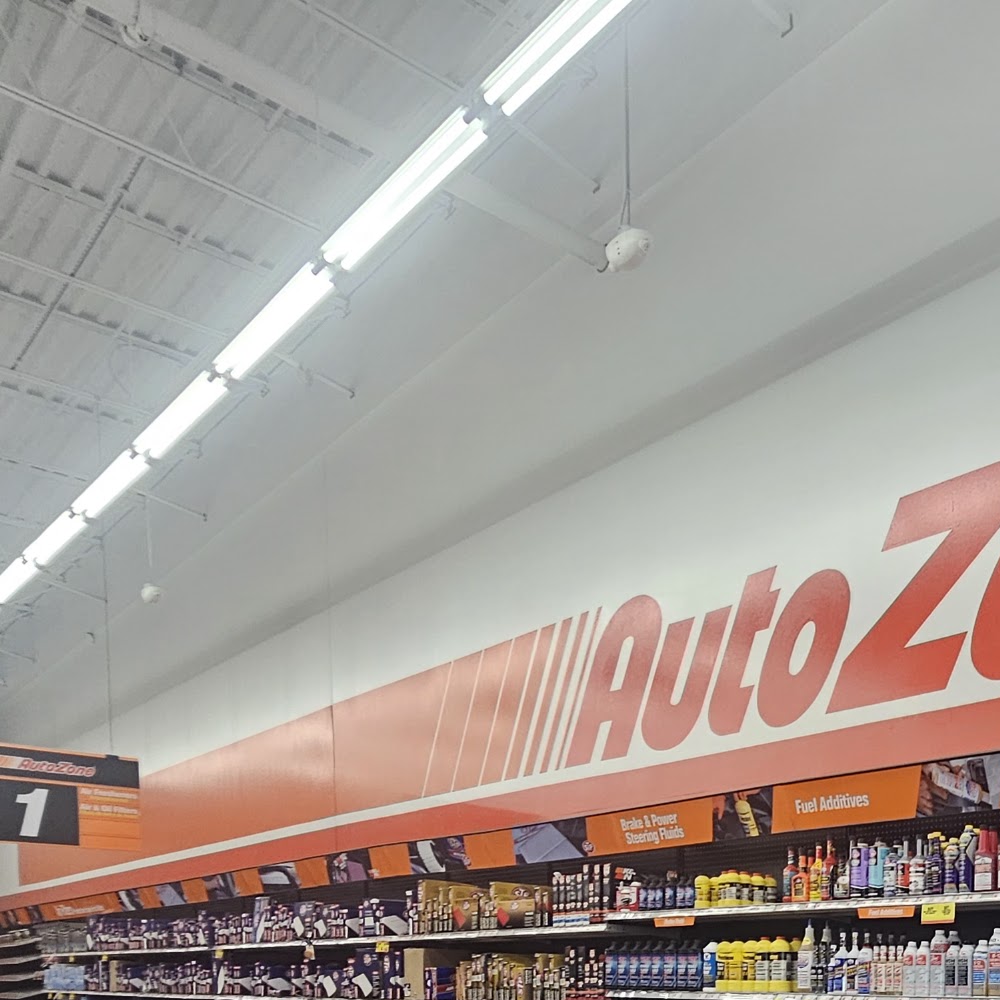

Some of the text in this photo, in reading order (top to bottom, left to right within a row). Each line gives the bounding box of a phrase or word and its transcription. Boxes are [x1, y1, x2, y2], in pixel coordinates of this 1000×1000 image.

[18, 758, 96, 777] AutoZone
[15, 788, 49, 837] 1
[795, 793, 870, 814] Fuel Additives
[620, 813, 678, 831] Brake & Power
[625, 825, 684, 845] Steering Fluids
